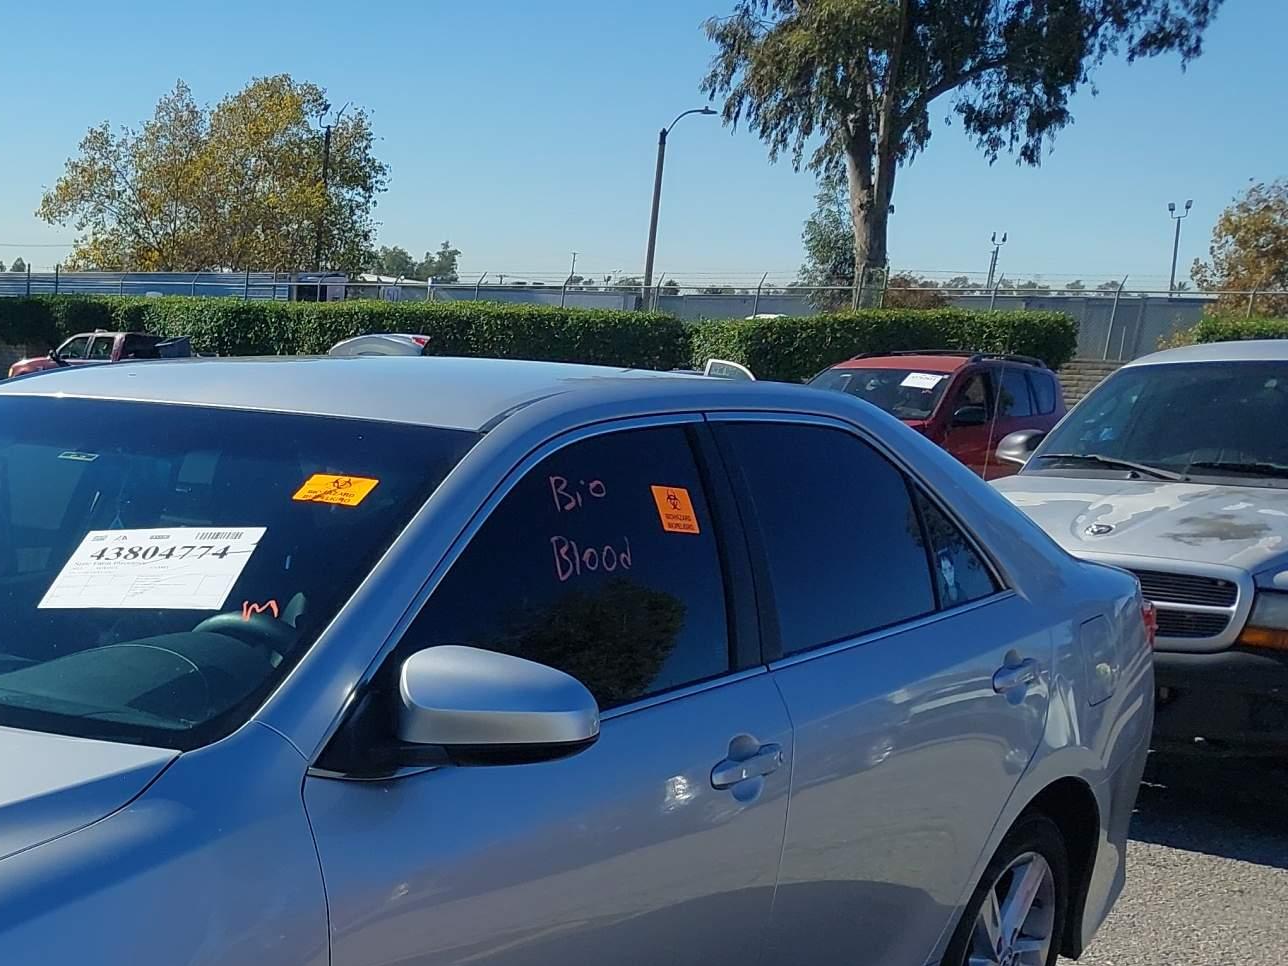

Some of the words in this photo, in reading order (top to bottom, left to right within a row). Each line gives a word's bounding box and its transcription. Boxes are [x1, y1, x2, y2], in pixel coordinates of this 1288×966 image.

[549, 475, 606, 513] Bio
[90, 545, 230, 561] 43804774
[550, 535, 632, 581] Blood
